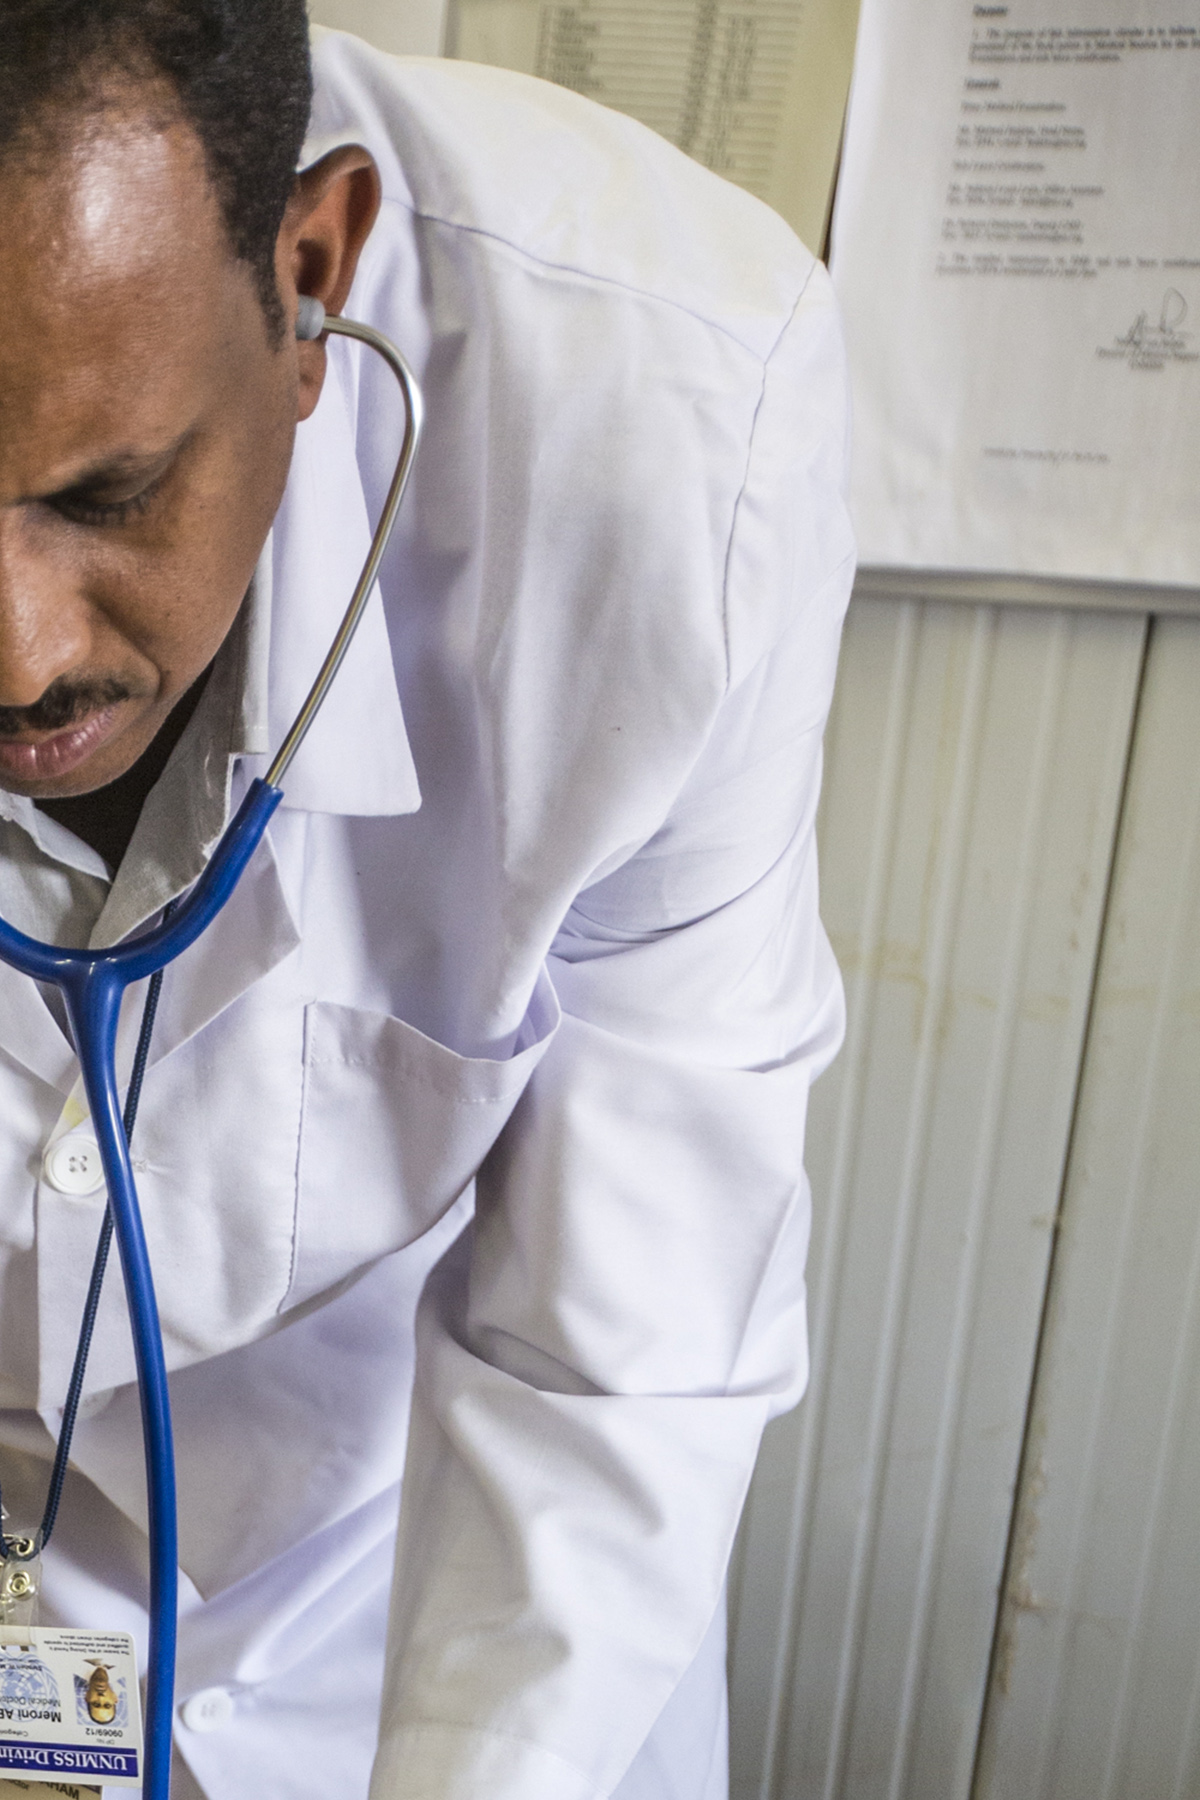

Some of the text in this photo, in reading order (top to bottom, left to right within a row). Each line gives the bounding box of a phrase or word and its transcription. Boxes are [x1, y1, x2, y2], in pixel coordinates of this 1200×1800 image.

[28, 1696, 62, 1707] Medical
[18, 1708, 62, 1723] Meroni
[53, 1752, 128, 1771] UNMISS
